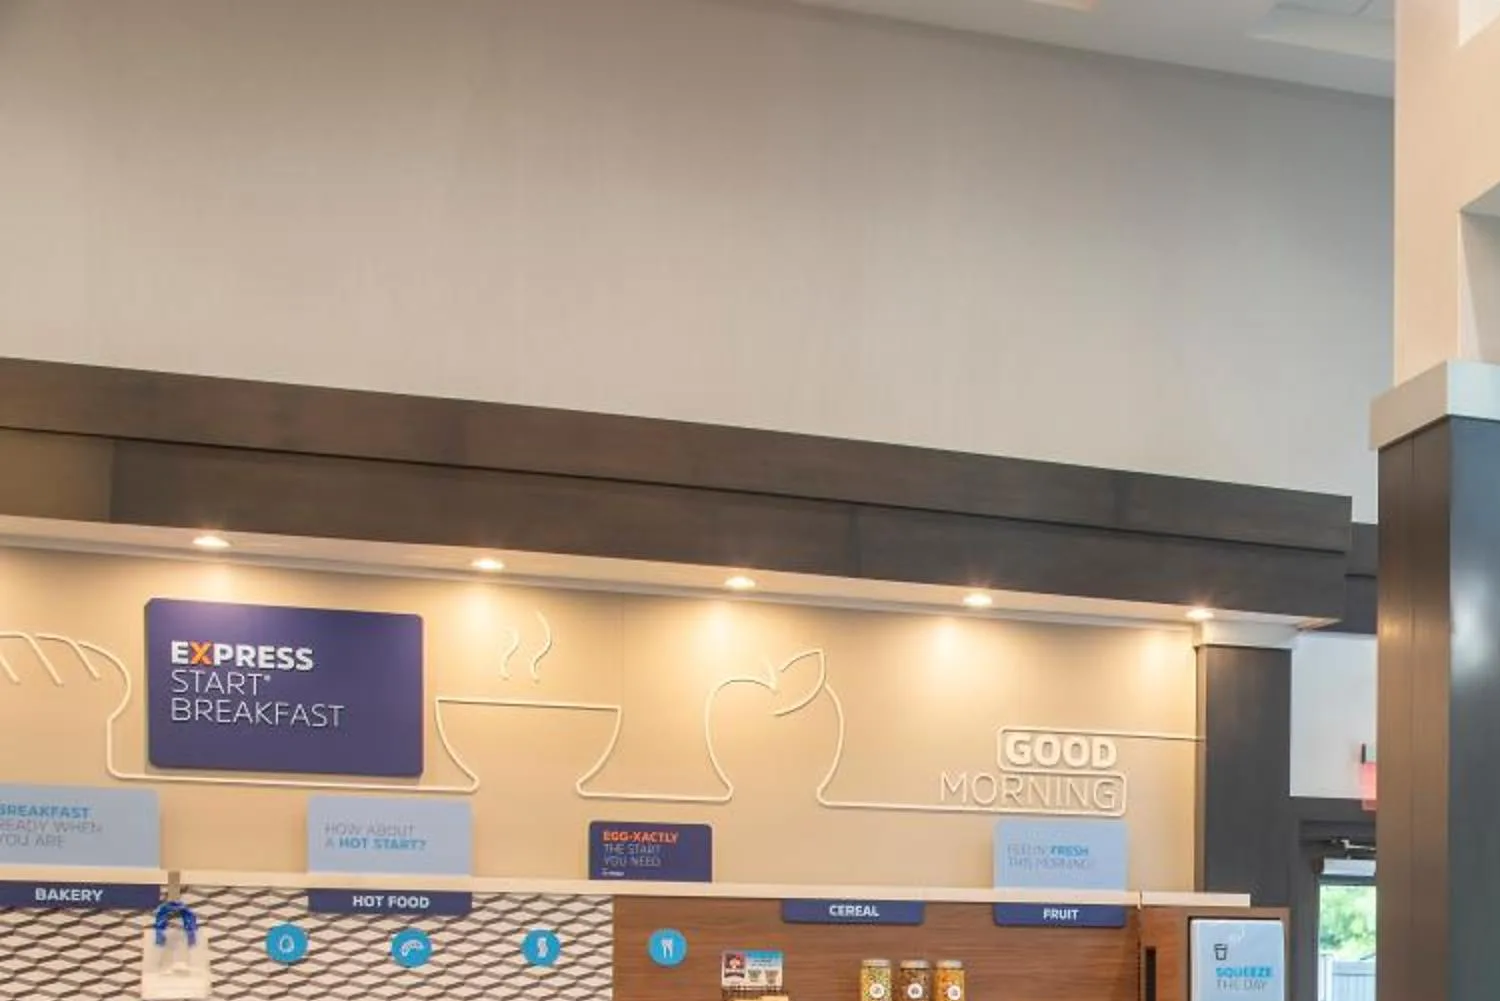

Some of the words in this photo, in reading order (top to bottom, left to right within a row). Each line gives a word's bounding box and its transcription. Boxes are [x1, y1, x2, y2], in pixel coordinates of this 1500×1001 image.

[171, 640, 314, 671] EXPRESS
[171, 698, 345, 727] BREAKFAST
[1005, 732, 1117, 769] GOOD
[940, 771, 1116, 809] MORNING
[325, 821, 361, 836] HOW
[367, 823, 415, 838] ABOUT
[35, 833, 66, 849] ARE
[325, 836, 336, 849] A
[339, 836, 368, 850] HOT
[373, 838, 427, 851] START?
[603, 830, 679, 844] EGG-XACTLY
[604, 843, 625, 855] THE
[628, 843, 661, 855] START
[1050, 845, 1089, 857] FRESH
[35, 887, 103, 901] BAKERY
[352, 895, 384, 908] HOT
[388, 896, 430, 909] FOOD
[829, 904, 880, 918] CEREAL
[1042, 907, 1080, 921] FRUIT
[1216, 967, 1272, 979] SQUEEZE
[1244, 979, 1268, 992] DAY
